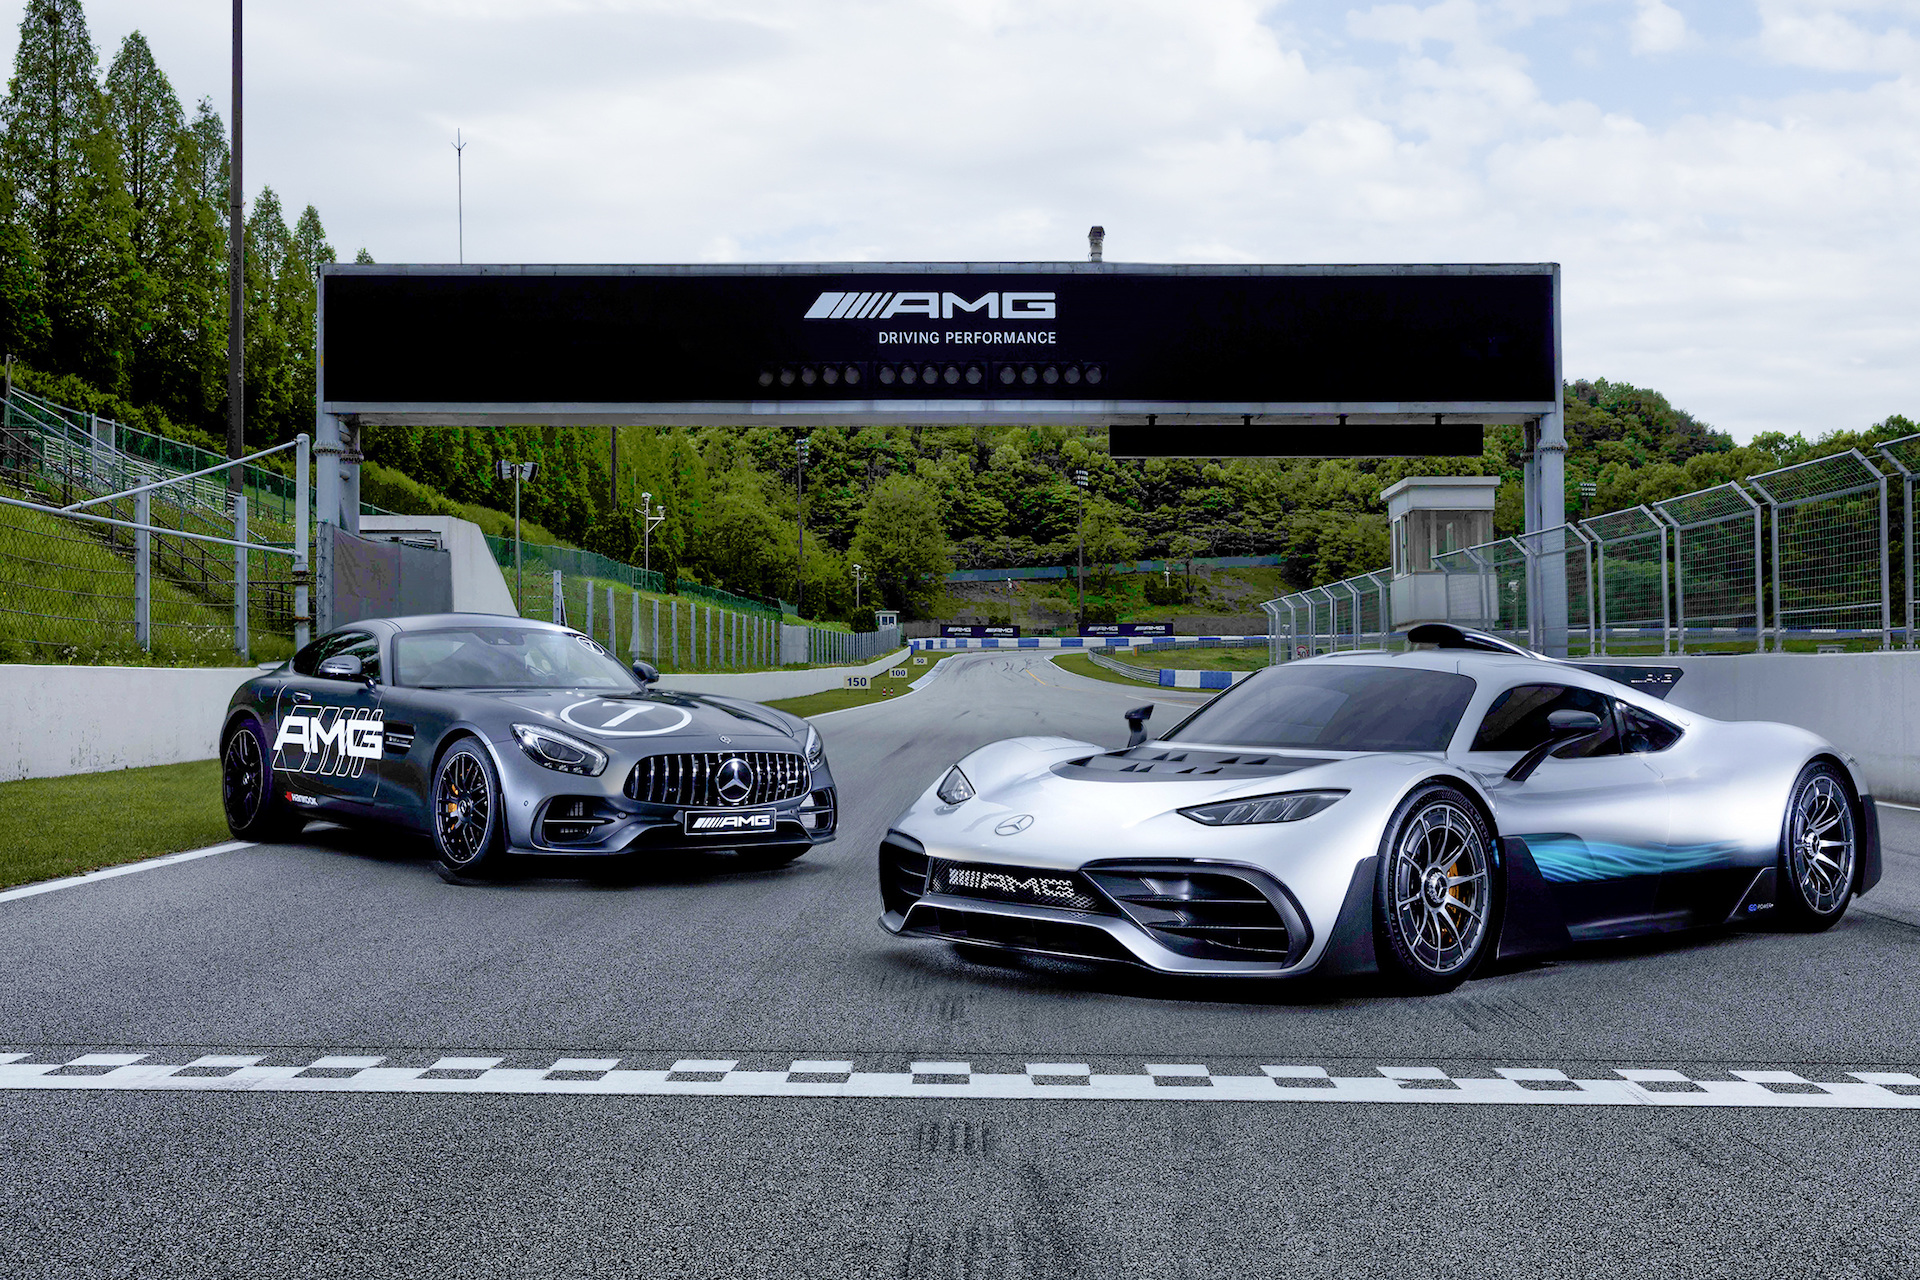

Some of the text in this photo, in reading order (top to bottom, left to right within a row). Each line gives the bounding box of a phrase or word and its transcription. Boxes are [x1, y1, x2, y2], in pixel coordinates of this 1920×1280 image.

[879, 292, 1056, 319] AMG
[879, 332, 1056, 344] DRIVING PERFORMANCE
[847, 677, 867, 687] 150
[601, 702, 655, 727] 7
[272, 715, 384, 760] AMG
[719, 815, 770, 828] AMG
[981, 872, 1075, 898] AMG
